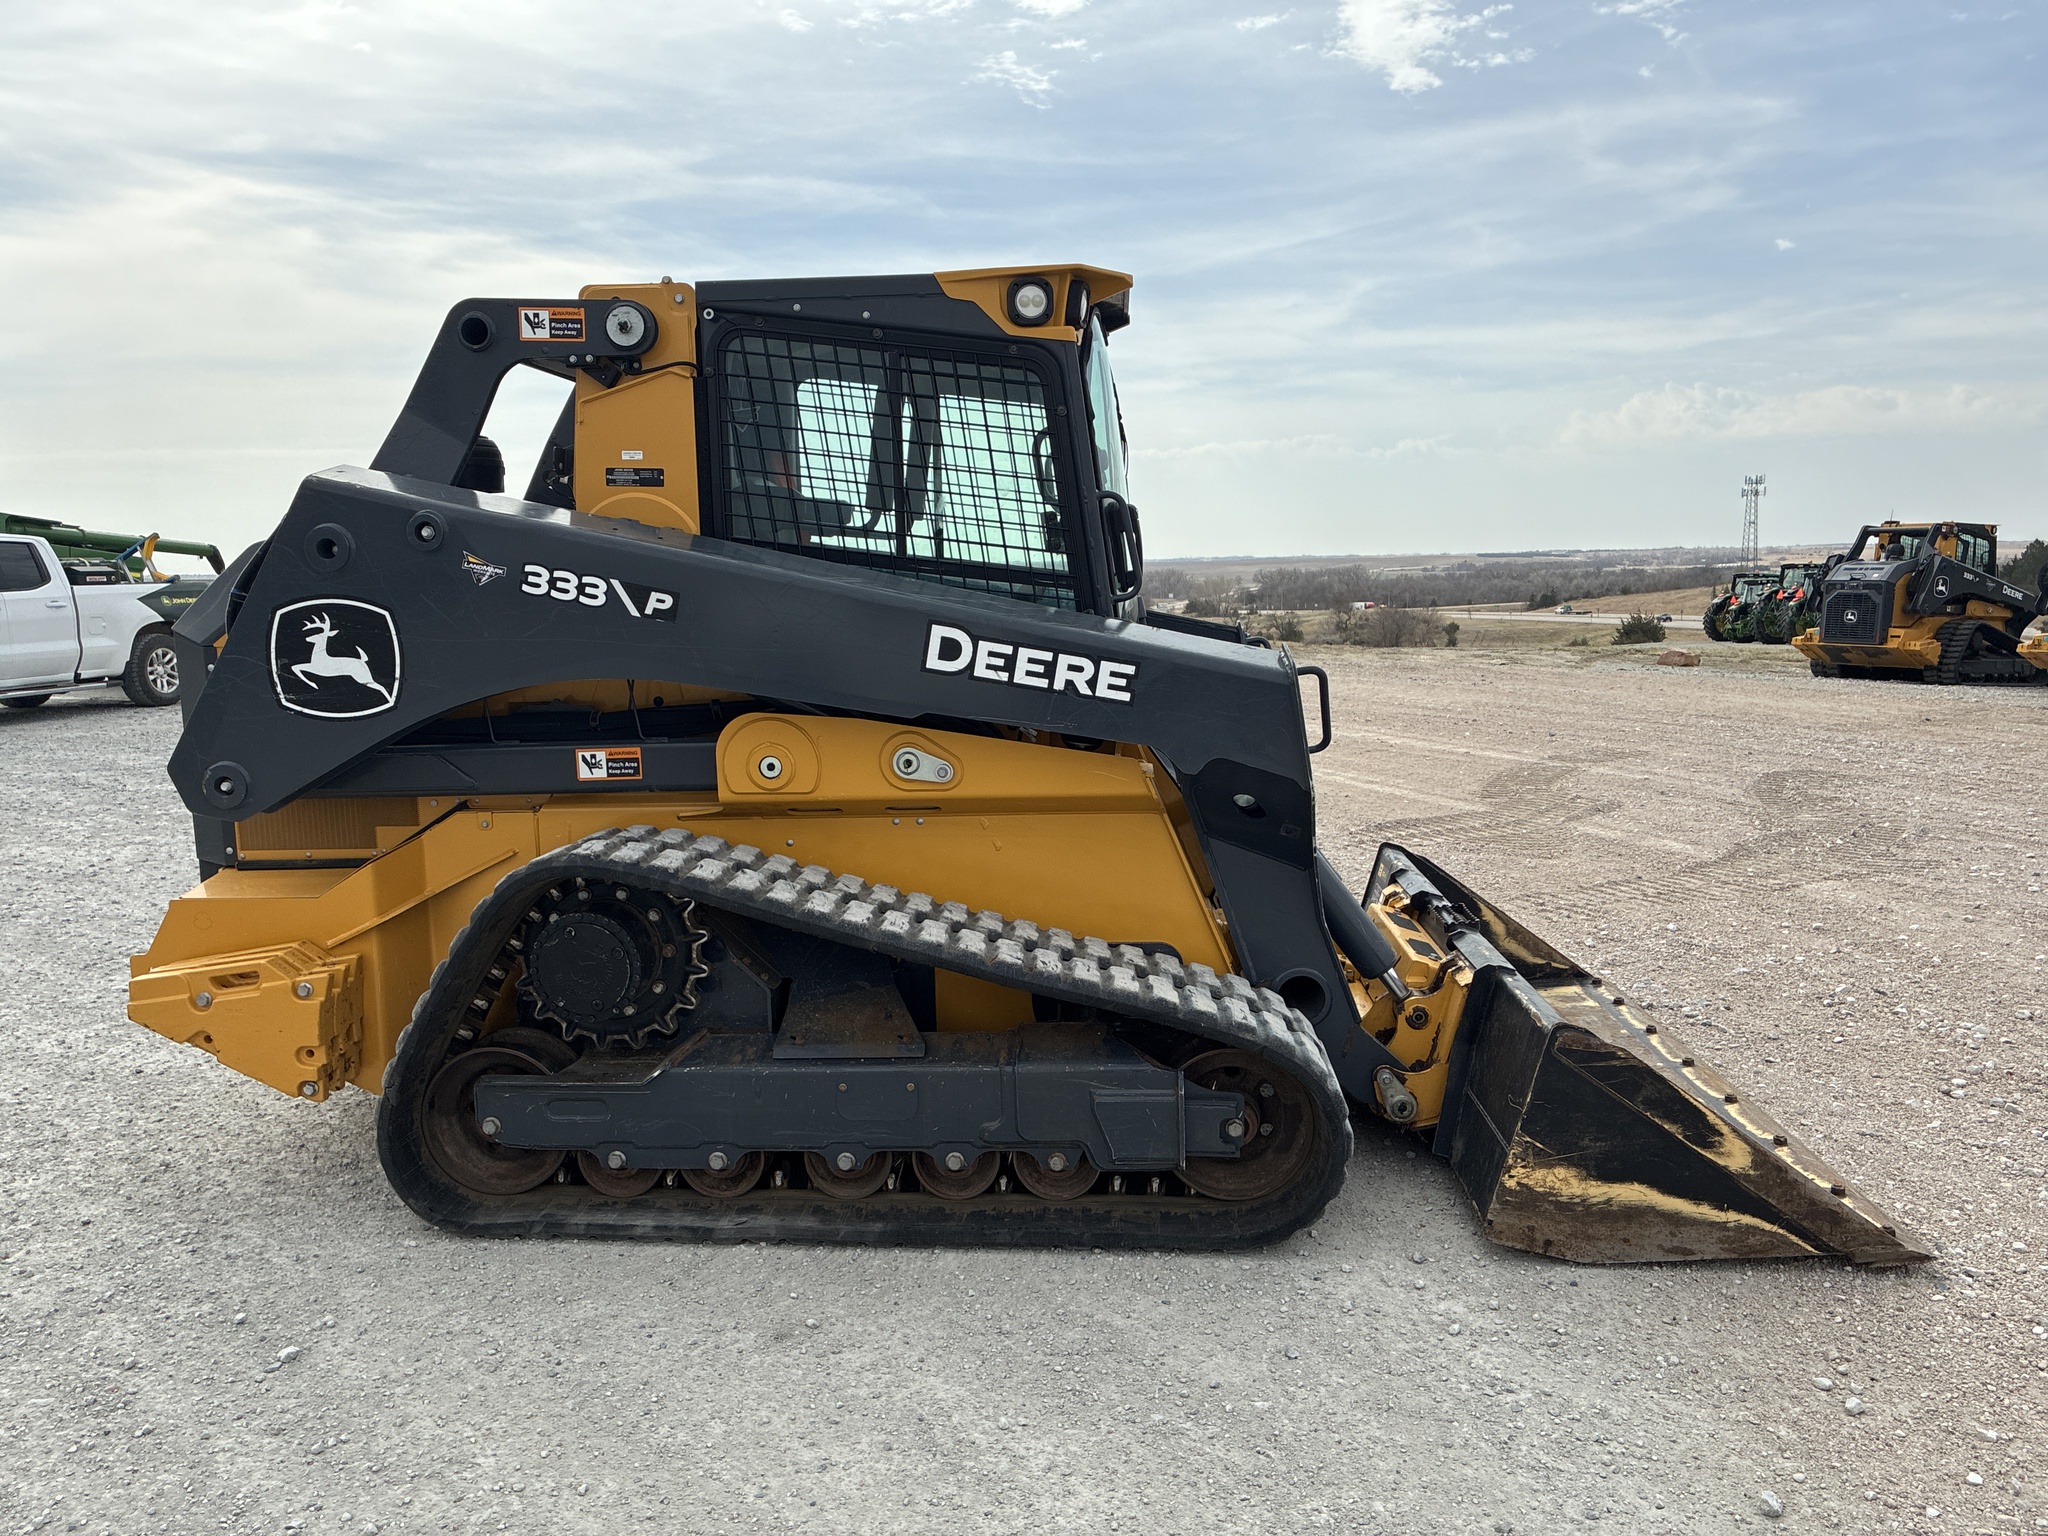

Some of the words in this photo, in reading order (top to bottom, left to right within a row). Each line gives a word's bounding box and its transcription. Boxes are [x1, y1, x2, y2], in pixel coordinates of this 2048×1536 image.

[464, 562, 504, 574] LANDMARK
[2002, 585, 2024, 600] DEERE
[926, 624, 1136, 702] DEERE
